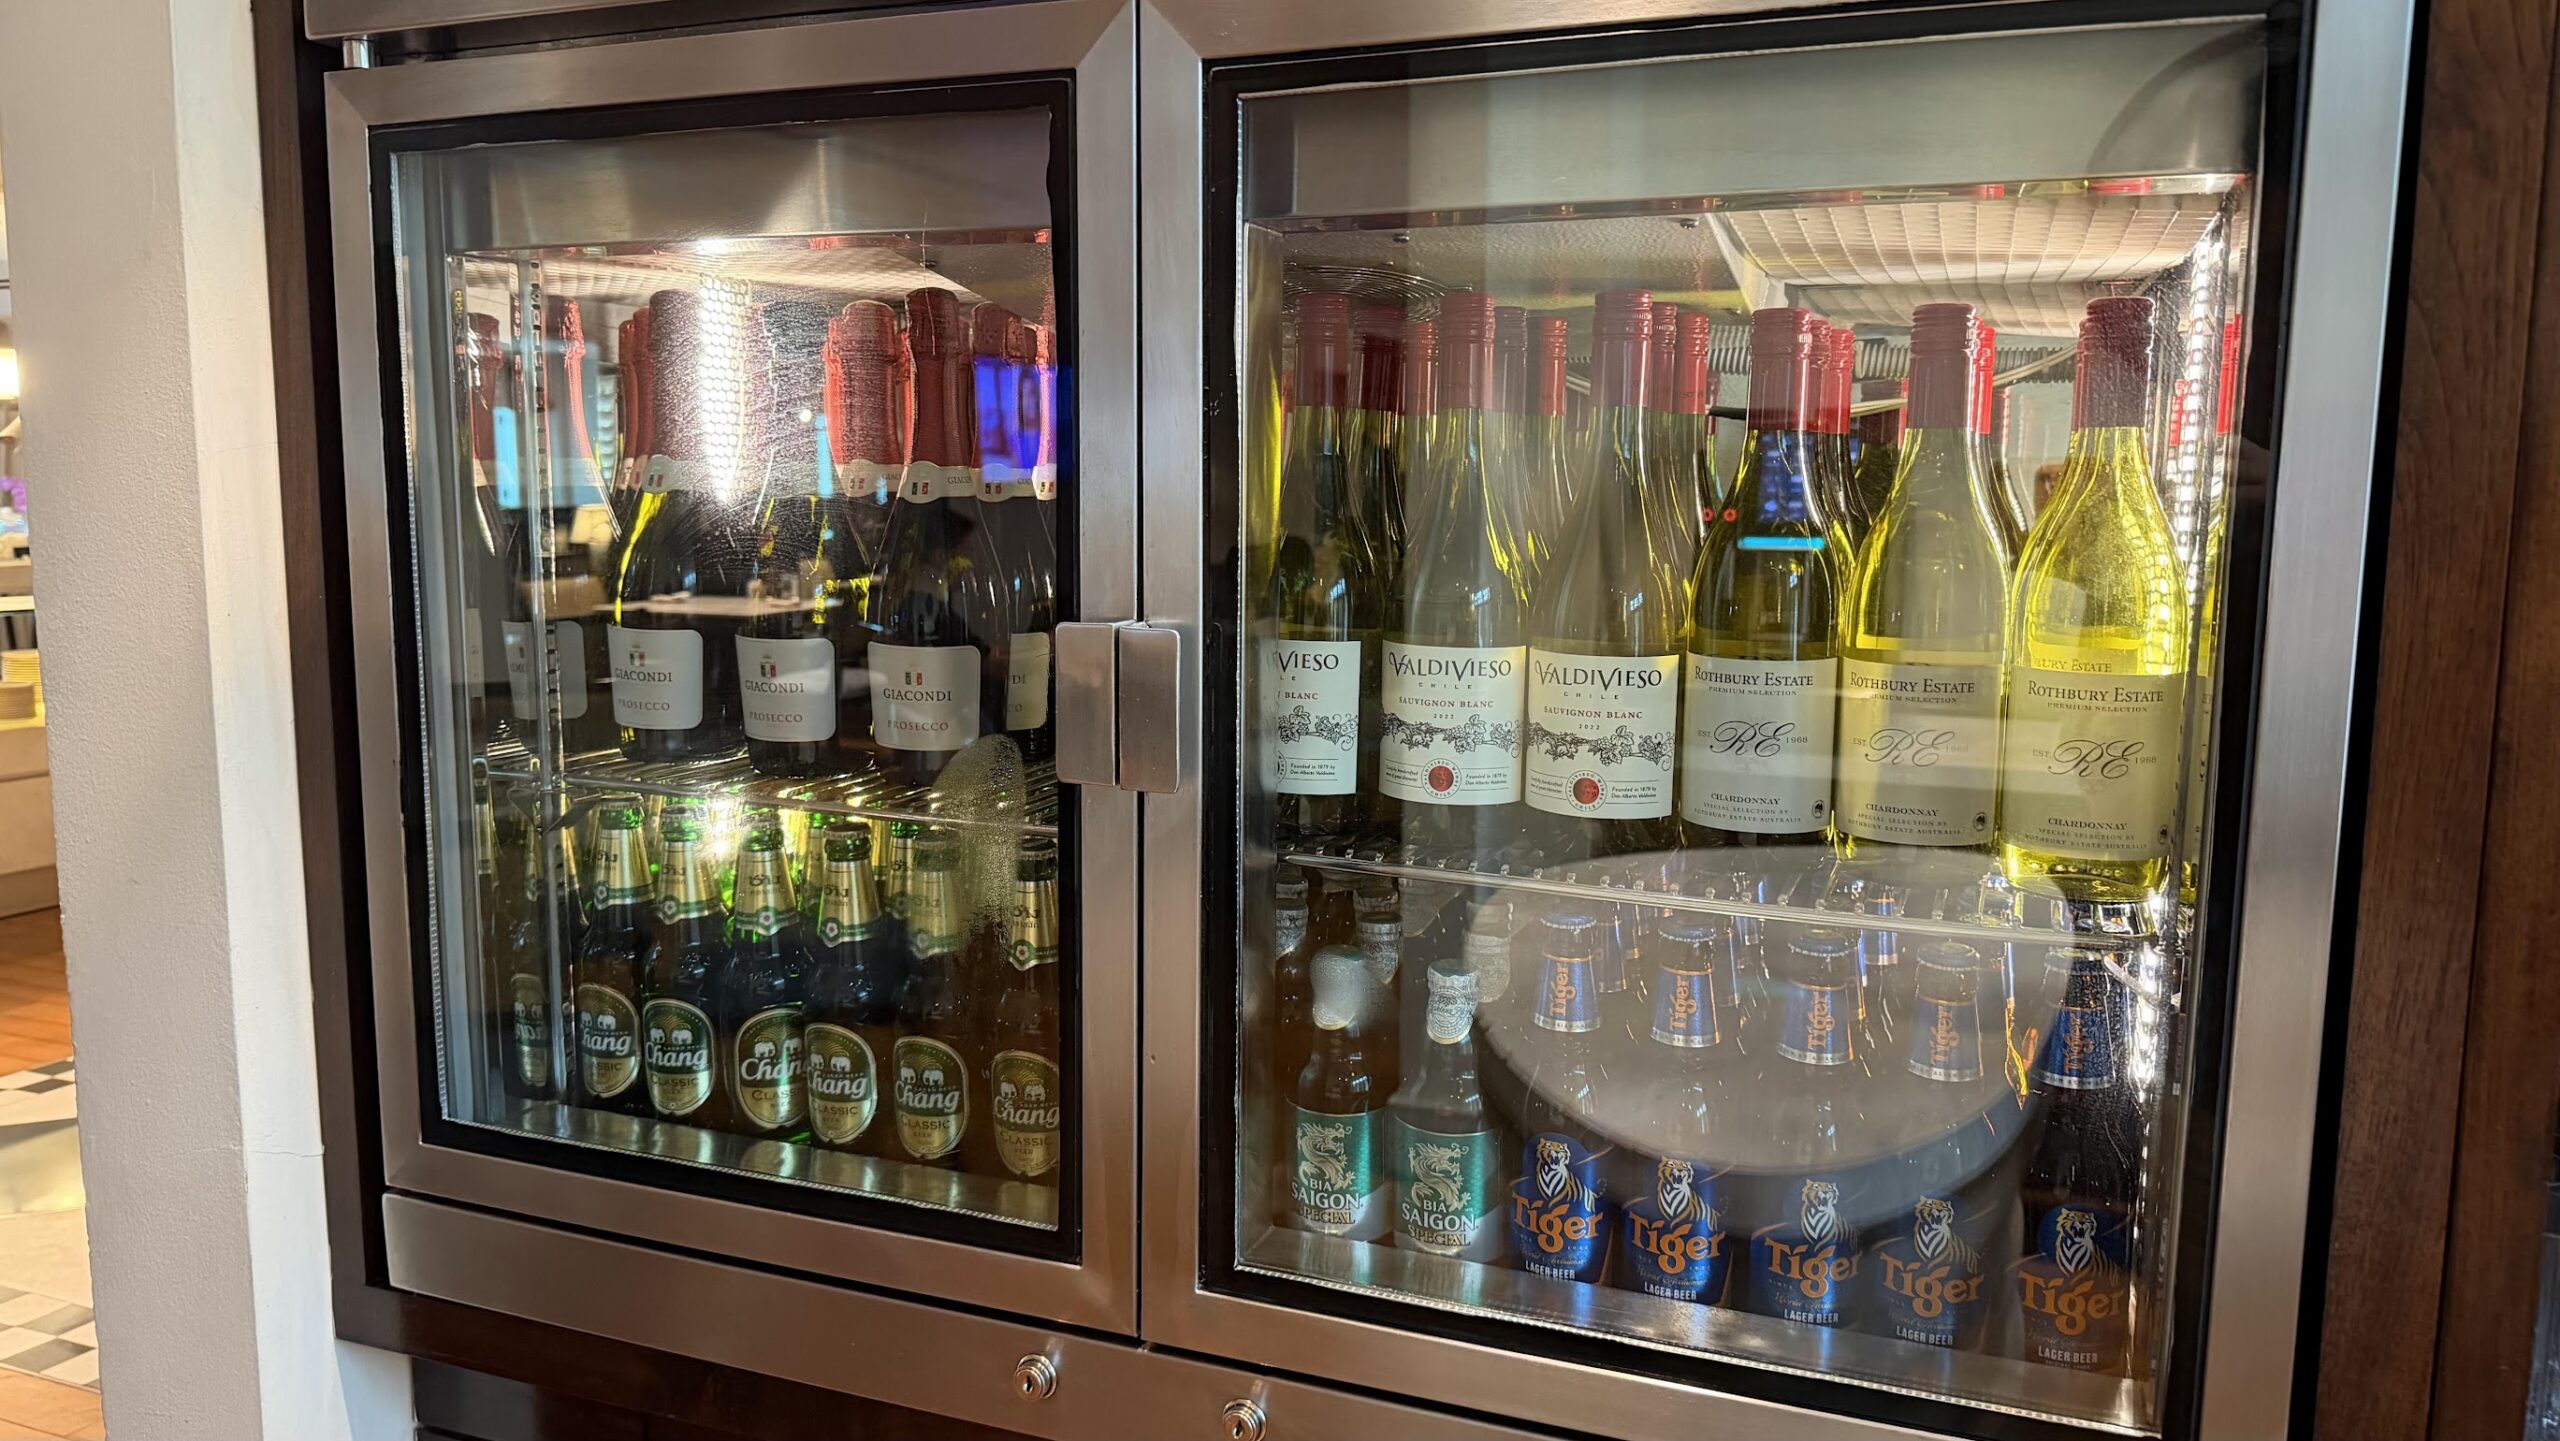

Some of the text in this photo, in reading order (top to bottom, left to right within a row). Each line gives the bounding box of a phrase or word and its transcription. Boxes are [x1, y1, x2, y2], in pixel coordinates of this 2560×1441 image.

[1388, 651, 1512, 682] VALDIVIESO
[2071, 658, 2113, 673] ESTATE
[614, 668, 673, 683] GIACONDI
[1535, 660, 1663, 692] VALDIVIESO
[1694, 665, 1814, 687] ROTHBURY ESTATE
[1849, 671, 1976, 694] ROTHBURY ESTATE
[745, 680, 805, 694] GIACONDI
[883, 688, 953, 702] GIACONDI
[1284, 691, 1319, 700] BLANC
[1418, 682, 1472, 690] CHILE
[1563, 691, 1620, 700] CHILE
[1708, 686, 1745, 695] PREMIUM
[2028, 680, 2164, 703] ROTHBURY ESTATE
[618, 699, 671, 712] PROSECCO
[1398, 696, 1494, 709] SAUVIGNON BLANC
[1904, 696, 1958, 704] SELECTION
[2047, 702, 2149, 713] PREMIUM SELECTION
[749, 711, 804, 724] PROSECCO
[1544, 706, 1643, 719] SAUVIGNON BLANC
[887, 720, 949, 732] PROSECCO
[1579, 723, 1600, 731] 2022
[1785, 736, 1808, 744] 1968
[2134, 756, 2157, 764] 1968
[1710, 792, 1781, 805] CHARDONNAY
[1865, 802, 1940, 817] CHARDONNAY
[2048, 817, 2128, 831] CHARDONNAY
[1549, 961, 1577, 1017] Tiger
[1668, 974, 1698, 1032] Tiger
[1806, 990, 1836, 1050] Tiger
[582, 1027, 632, 1056] hang
[1929, 1005, 1960, 1065] Tiger
[2063, 1013, 2094, 1074] Tiger
[644, 1041, 709, 1070] Chang
[741, 1058, 807, 1081] Chan
[652, 1076, 699, 1087] CLASSIC
[807, 1066, 869, 1099] Chang
[751, 1088, 798, 1101] CLASS
[895, 1080, 961, 1113] Chang
[994, 1096, 1060, 1128] Chang
[1309, 1178, 1332, 1192] BIA
[1291, 1181, 1360, 1211] SAIGON
[1423, 1199, 1447, 1213] BIA
[1401, 1202, 1476, 1232] SAIGON
[1512, 1191, 1604, 1254] Tiger
[1407, 1224, 1471, 1247] SPECIAL
[1628, 1210, 1727, 1275] Tiger
[1525, 1259, 1576, 1280] LAGER BEER
[1764, 1237, 1864, 1298] Tiger
[1644, 1280, 1697, 1300] LAGER BEER
[1880, 1251, 1985, 1318] Tiger
[2018, 1270, 2125, 1336] Tiger
[1783, 1308, 1840, 1324] LAGER BEER
[1896, 1325, 1954, 1346] LAGER BEER
[2038, 1345, 2098, 1364] LAGER BEER
